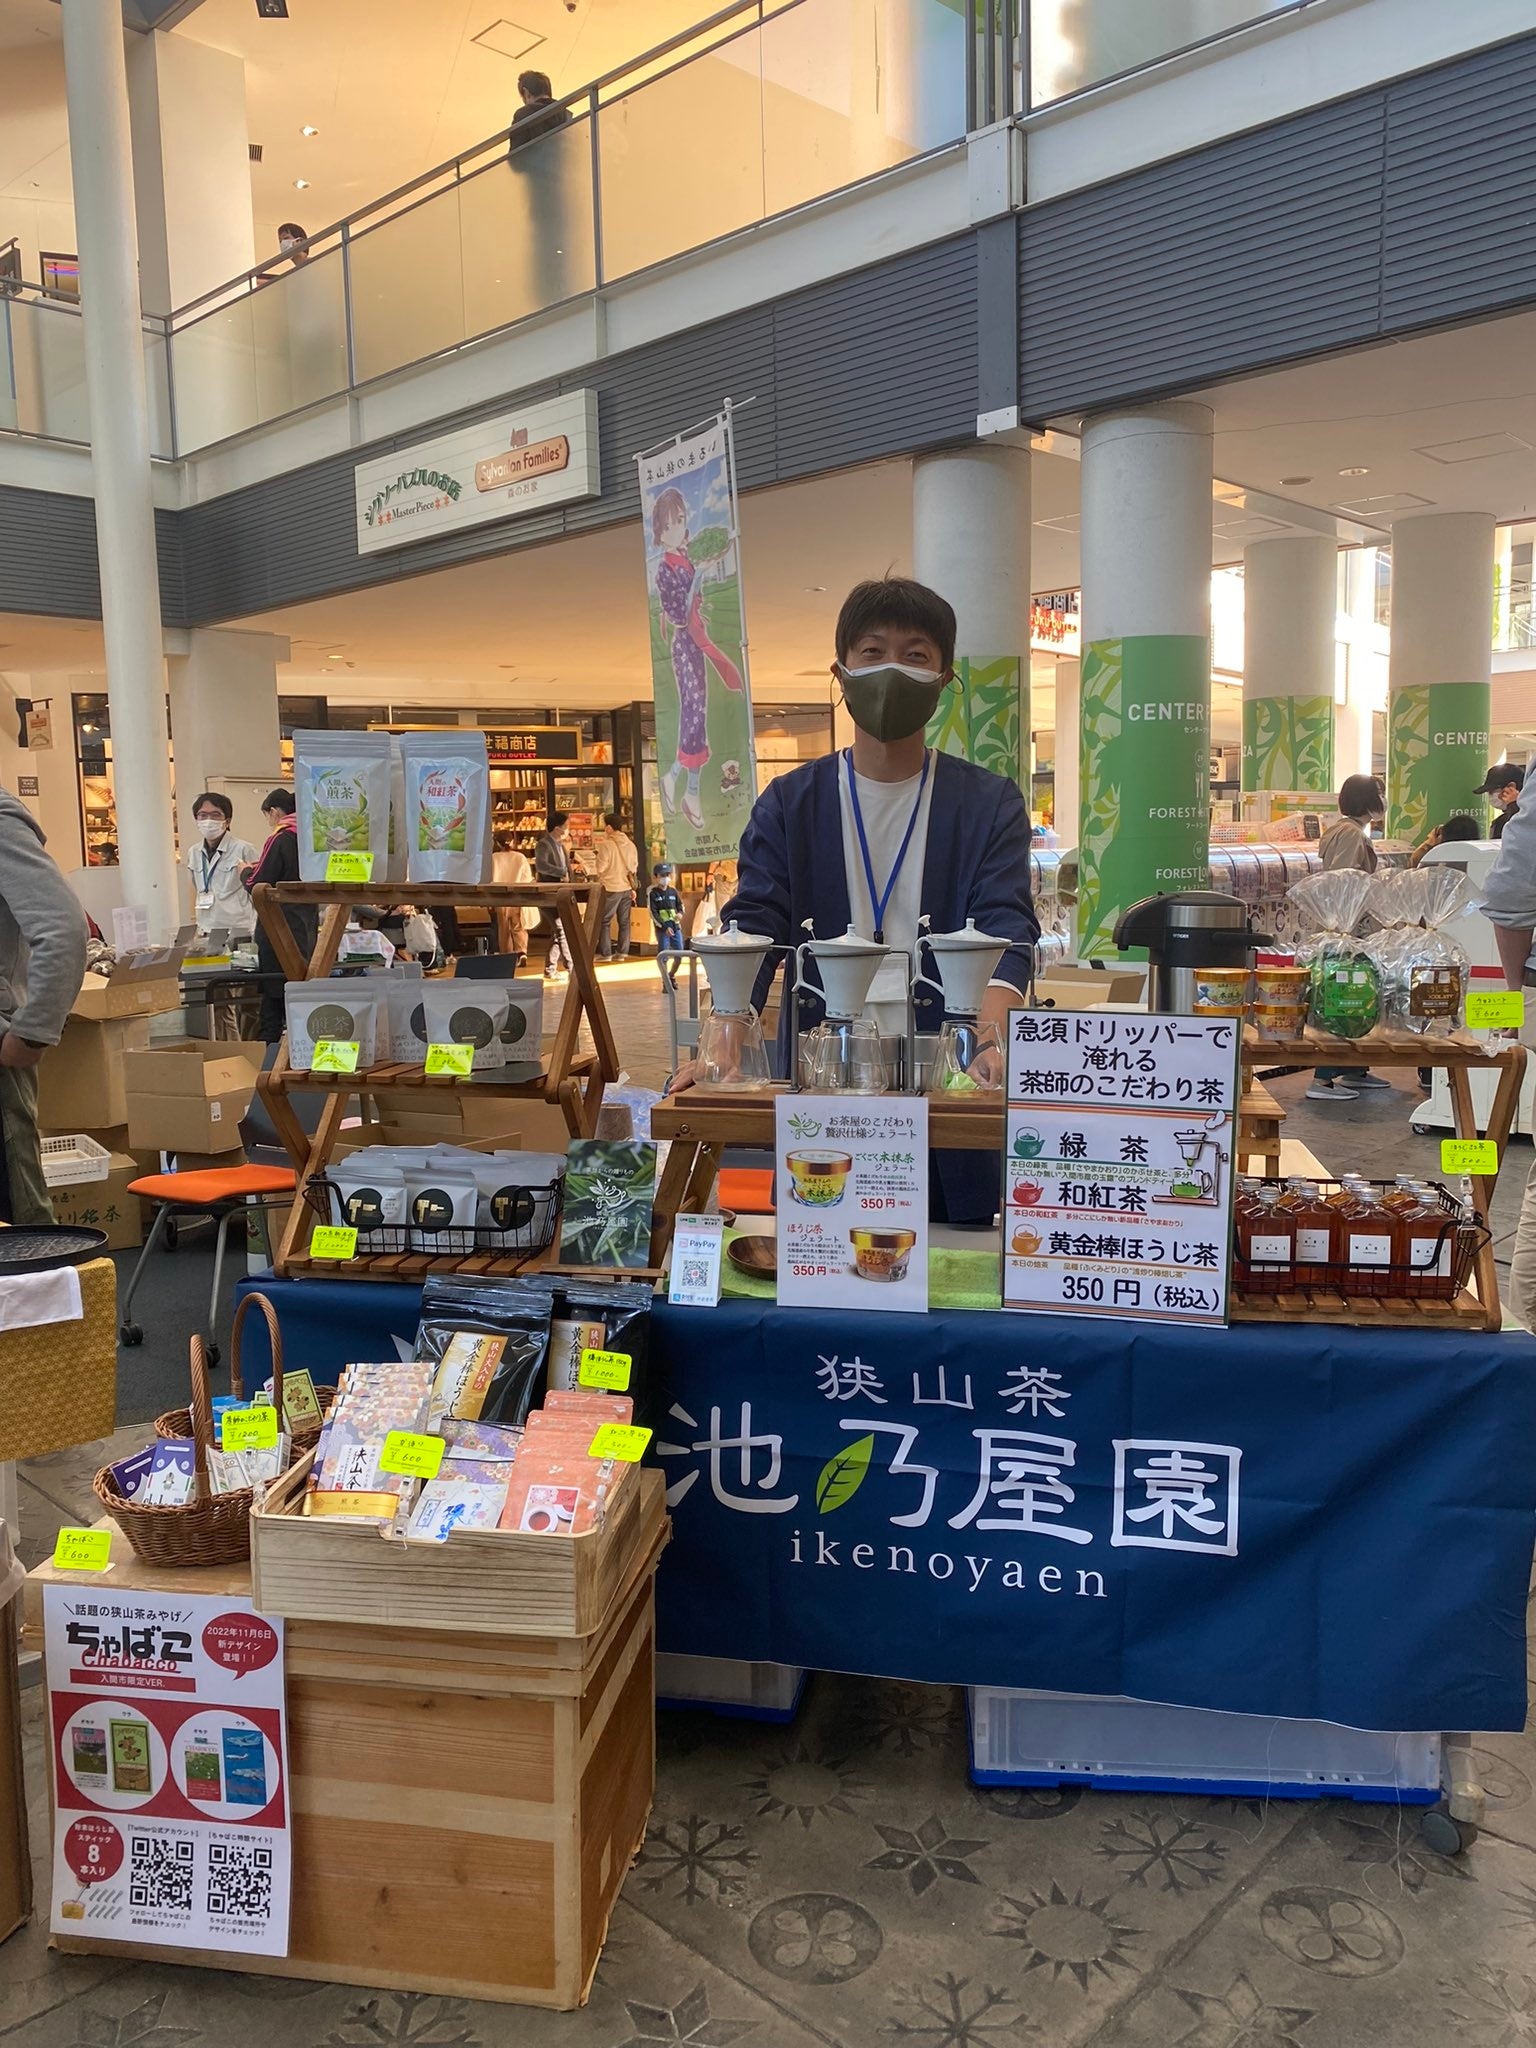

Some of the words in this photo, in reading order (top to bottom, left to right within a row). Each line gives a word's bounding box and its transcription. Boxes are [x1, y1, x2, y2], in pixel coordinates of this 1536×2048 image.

[523, 446, 561, 471] Families
[1127, 703, 1206, 721] CENTER
[1433, 732, 1488, 746] CENTER
[327, 786, 354, 800] 煎茶
[427, 785, 458, 797] 和紅茶
[1149, 807, 1196, 818] FOREST
[1015, 1016, 1233, 1049] 急須ドリッパーで
[1082, 1045, 1157, 1072] 淹れる
[1019, 1069, 1225, 1104] 茶師のこだわり茶
[829, 1115, 914, 1128] お茶屋のこだわり
[825, 1126, 917, 1140] 贅沢仕様ジェラート
[875, 1164, 916, 1173] ジェラート
[1058, 1181, 1147, 1212] 和紅茶
[1013, 1208, 1058, 1219] 本日の和紅茶
[787, 1223, 824, 1234] ほうじ茶
[690, 1240, 716, 1249] PayPay
[800, 1234, 840, 1243] ジェラート
[1048, 1231, 1219, 1267] 黄金棒ほうじ茶
[442, 1338, 486, 1419] 黄金棒ほうじ
[816, 1354, 1072, 1418] 狭山茶
[790, 1530, 1108, 1598] ikenoyaen
[206, 1626, 273, 1640] 2022年11月6日
[65, 1621, 193, 1663] ちゃばこ
[217, 1639, 262, 1651] 新デザイン
[100, 1673, 166, 1688] 入間市限定VER.
[78, 1834, 112, 1844] スティック
[88, 1844, 100, 1863] 8
[80, 1864, 106, 1877] 本入り
